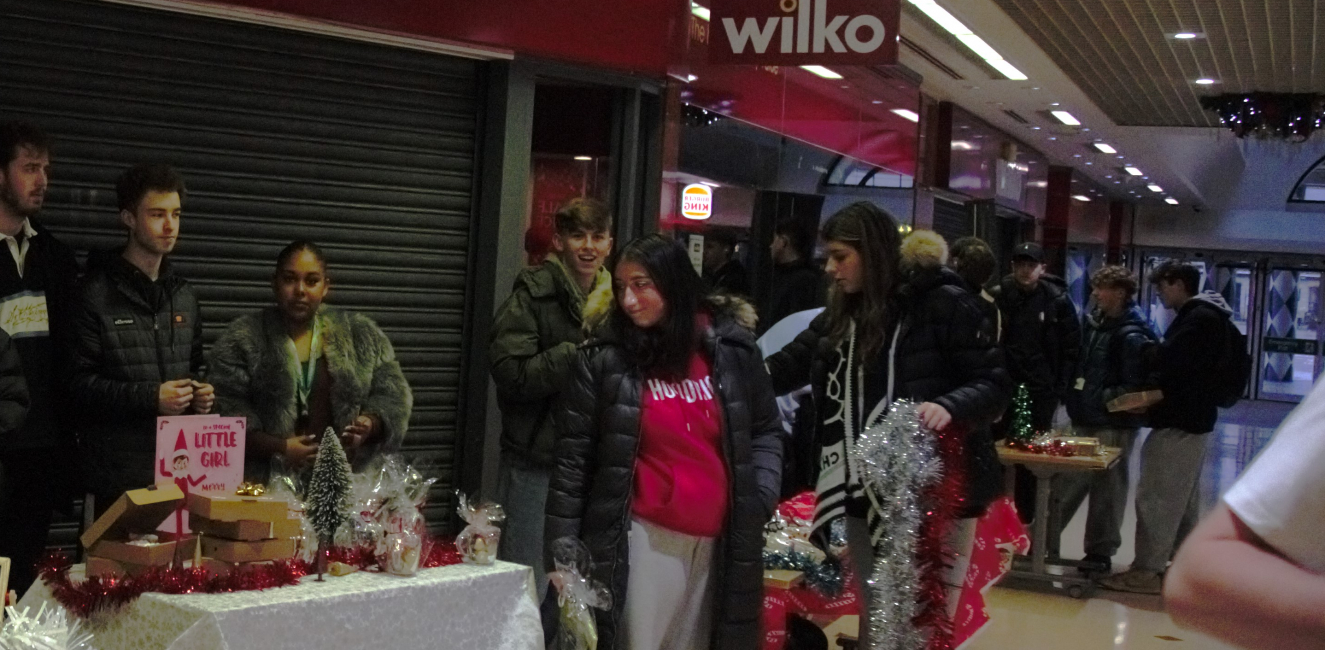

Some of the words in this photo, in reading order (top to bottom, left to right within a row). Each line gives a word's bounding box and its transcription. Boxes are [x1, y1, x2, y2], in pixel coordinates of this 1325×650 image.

[721, 0, 886, 54] wilko
[194, 431, 237, 449] LITTLE
[200, 450, 231, 468] GIRL
